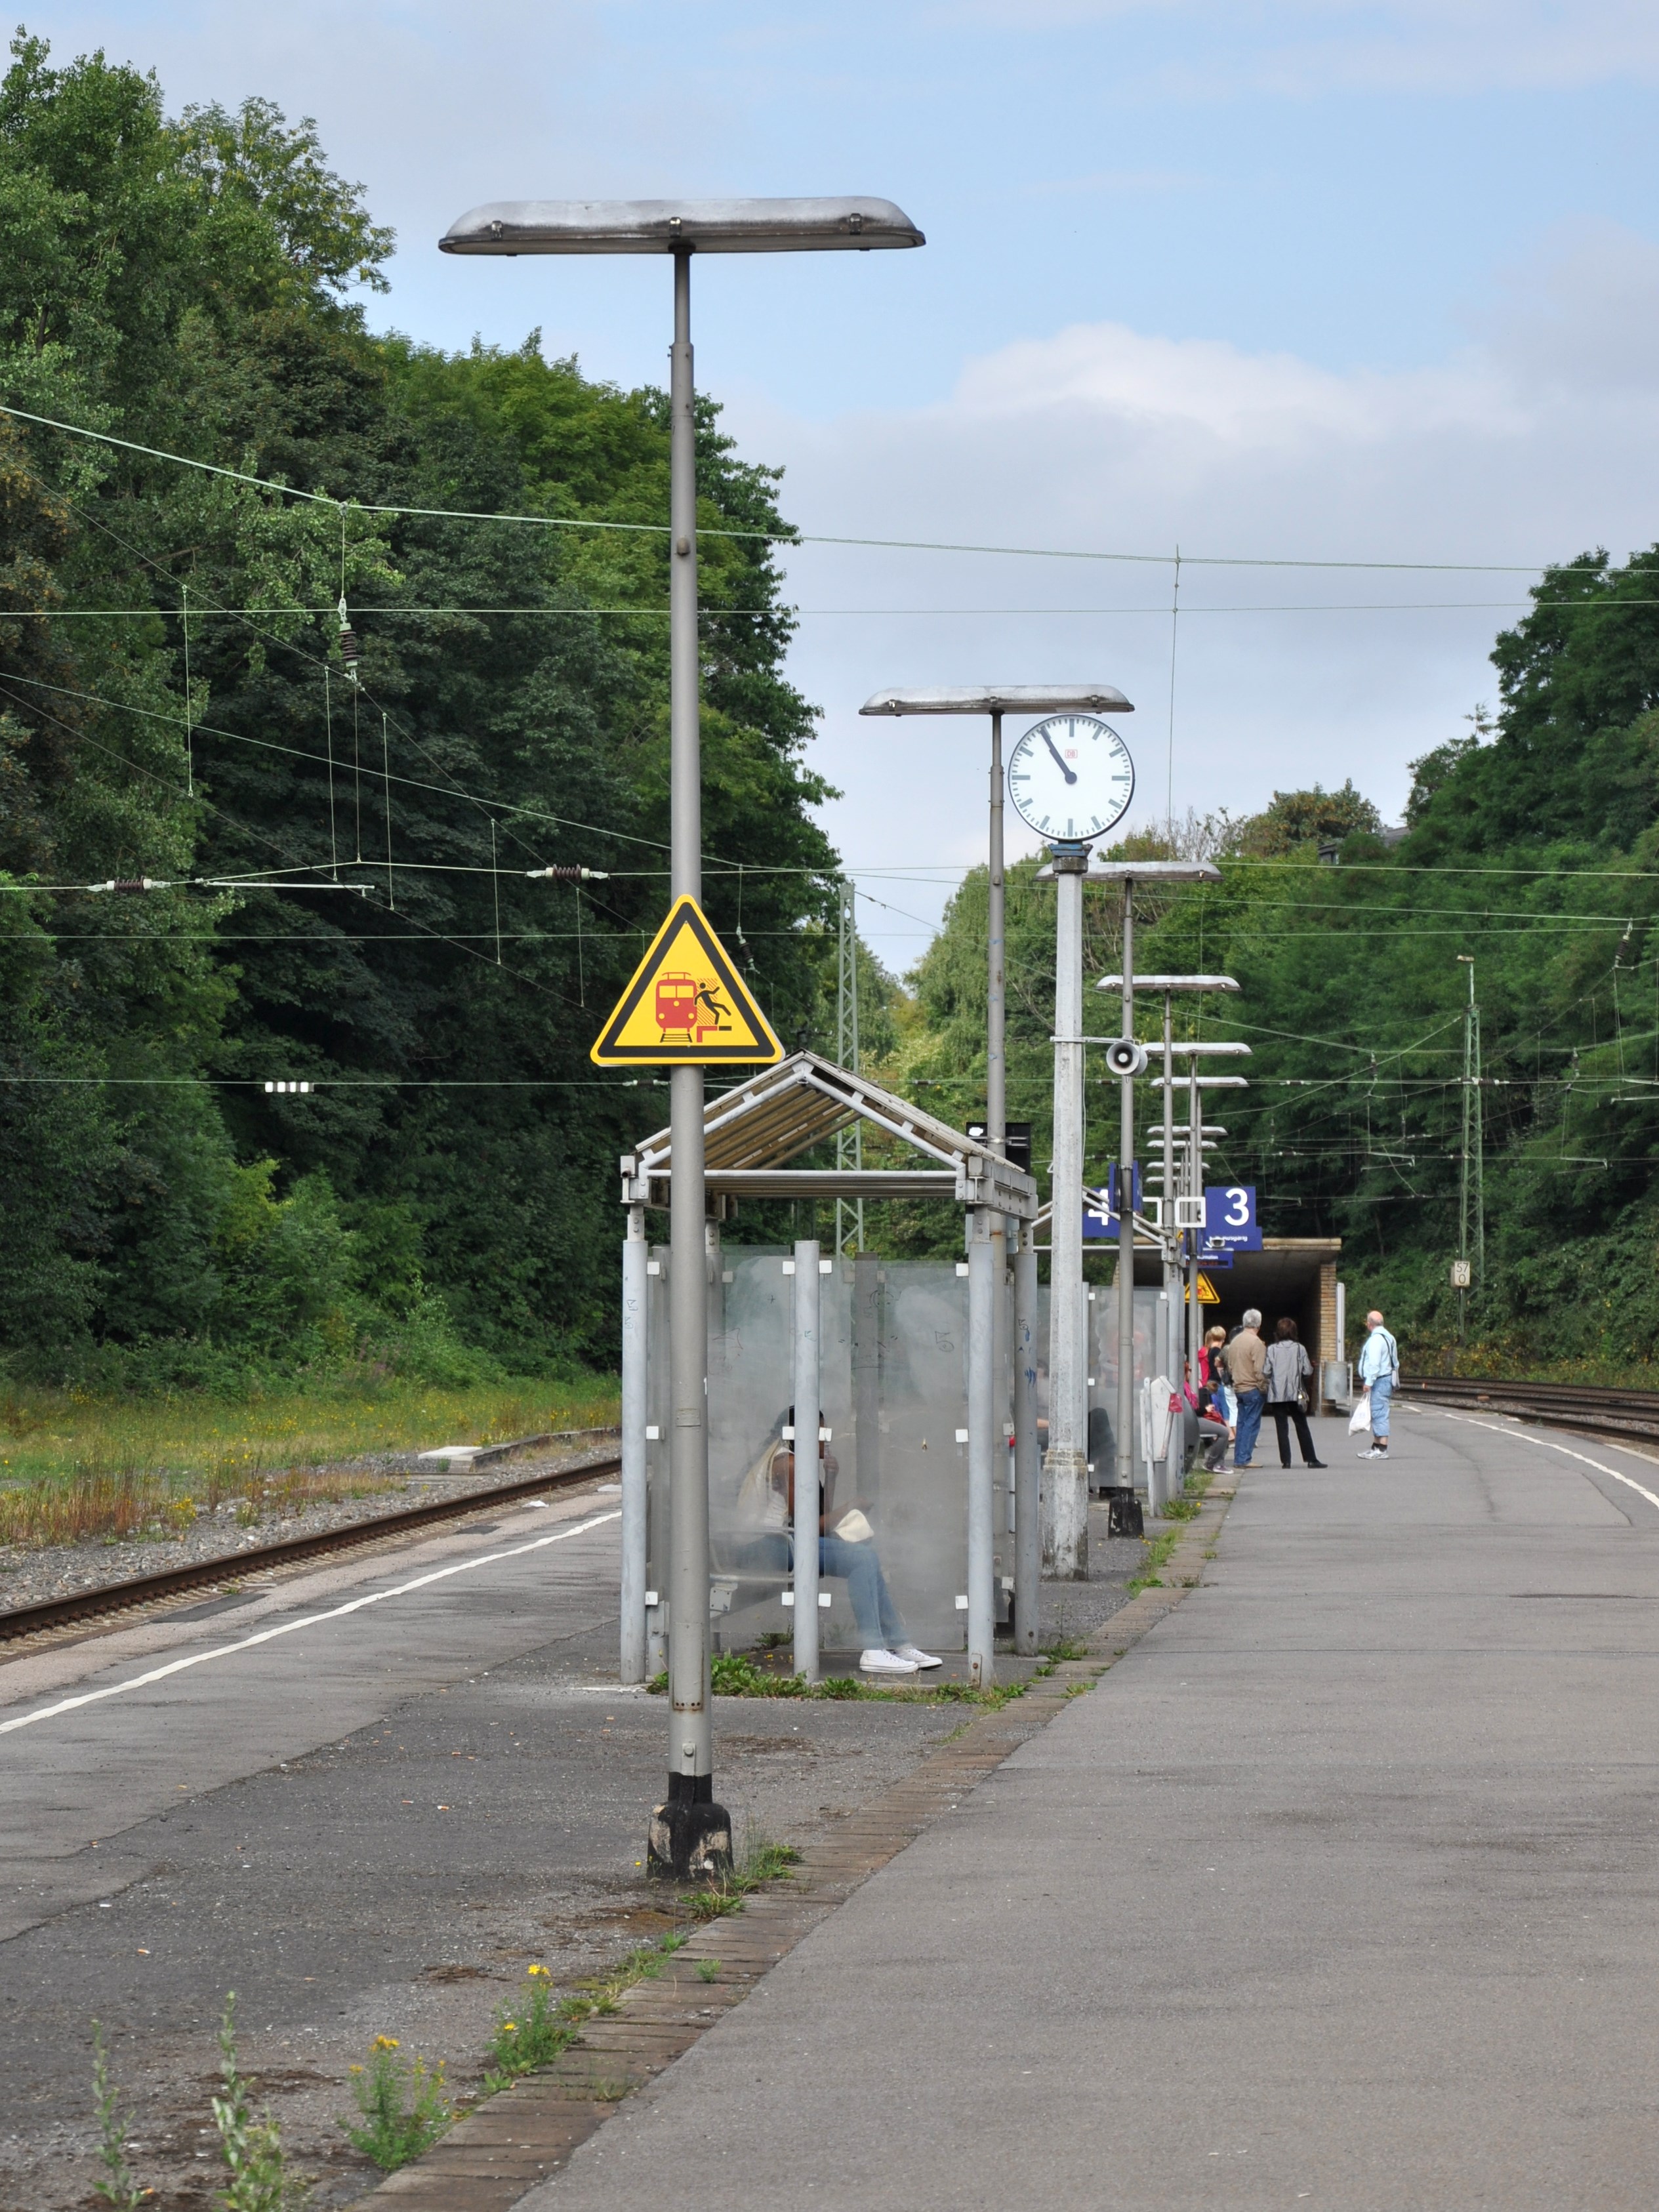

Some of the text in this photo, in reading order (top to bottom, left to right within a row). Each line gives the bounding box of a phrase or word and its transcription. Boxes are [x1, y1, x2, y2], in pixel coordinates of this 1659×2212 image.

[1088, 1188, 1111, 1226] 4
[1224, 1187, 1250, 1226] 3
[1456, 1262, 1469, 1273] 57
[1458, 1274, 1466, 1284] 0
